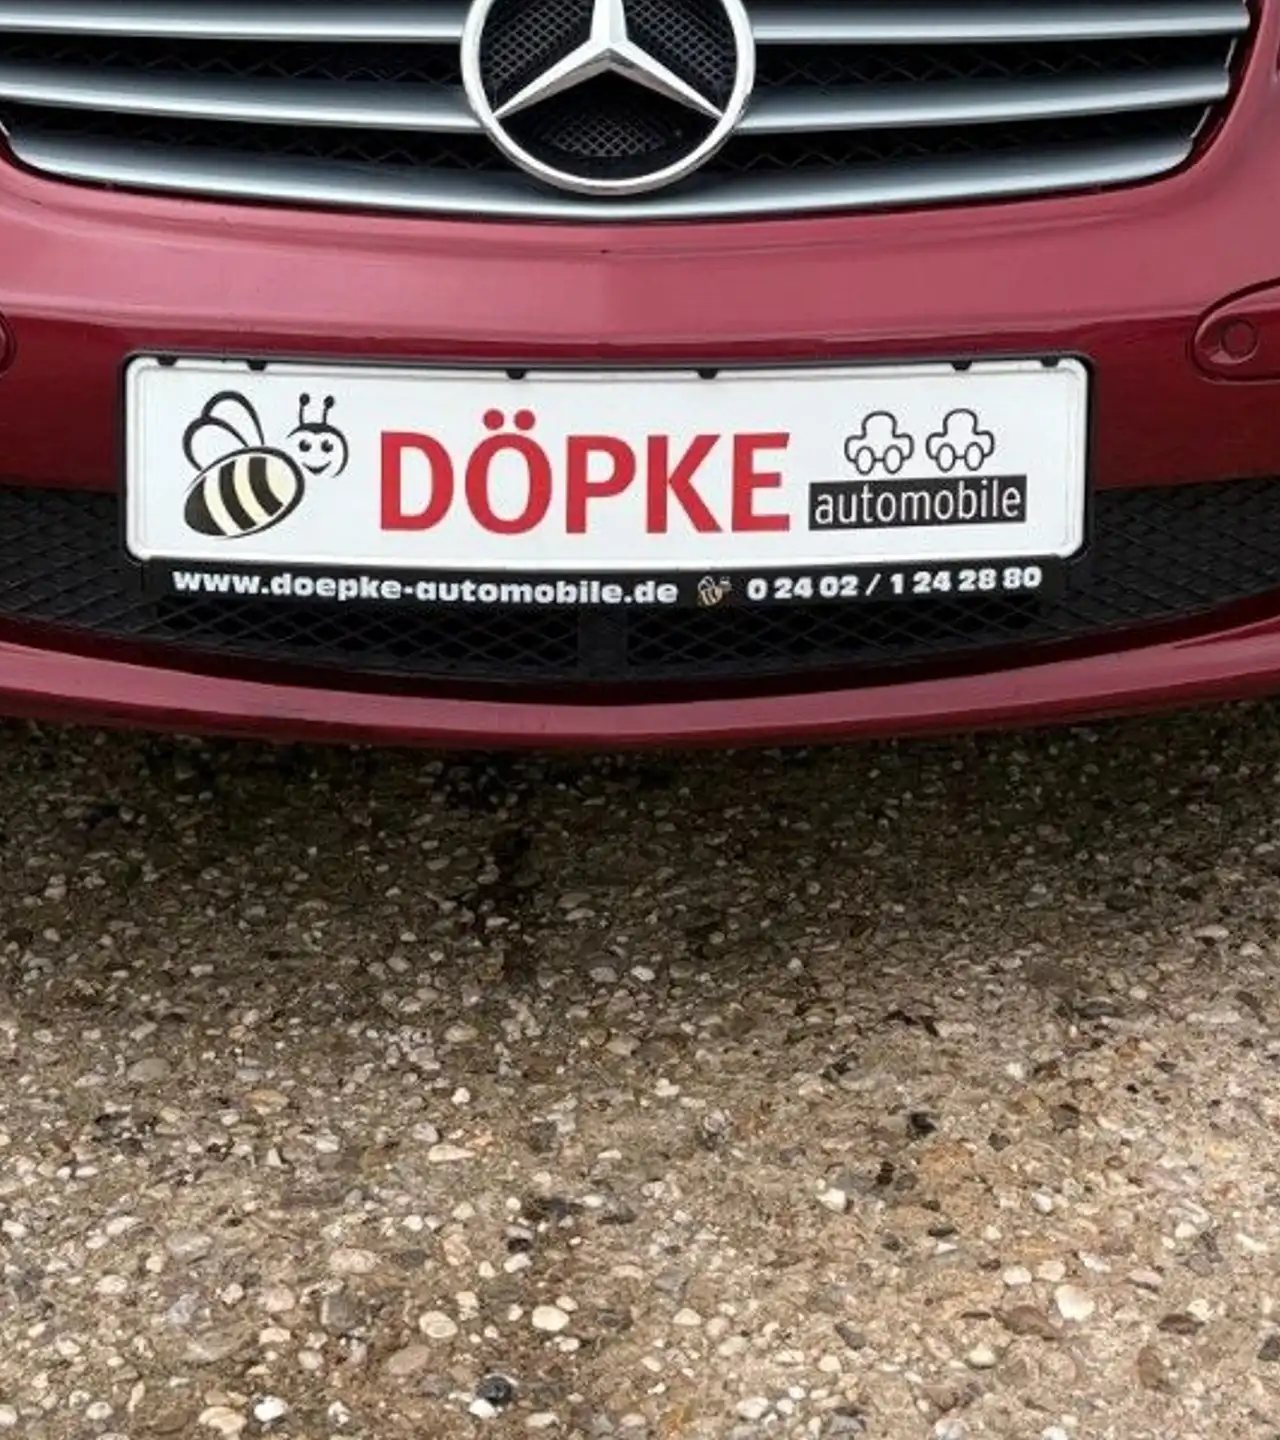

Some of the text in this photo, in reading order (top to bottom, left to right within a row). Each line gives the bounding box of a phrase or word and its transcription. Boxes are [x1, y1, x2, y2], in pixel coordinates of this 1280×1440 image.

[380, 409, 791, 535] DÖPKE
[814, 481, 1023, 525] automobile
[172, 570, 679, 604] www.doepke-automobile.de
[747, 578, 768, 601] 0
[774, 576, 814, 599] 24
[819, 574, 859, 598] 02
[890, 573, 904, 594] 1
[913, 571, 952, 594] 24
[958, 569, 997, 591] 28
[1002, 566, 1042, 590] 80
